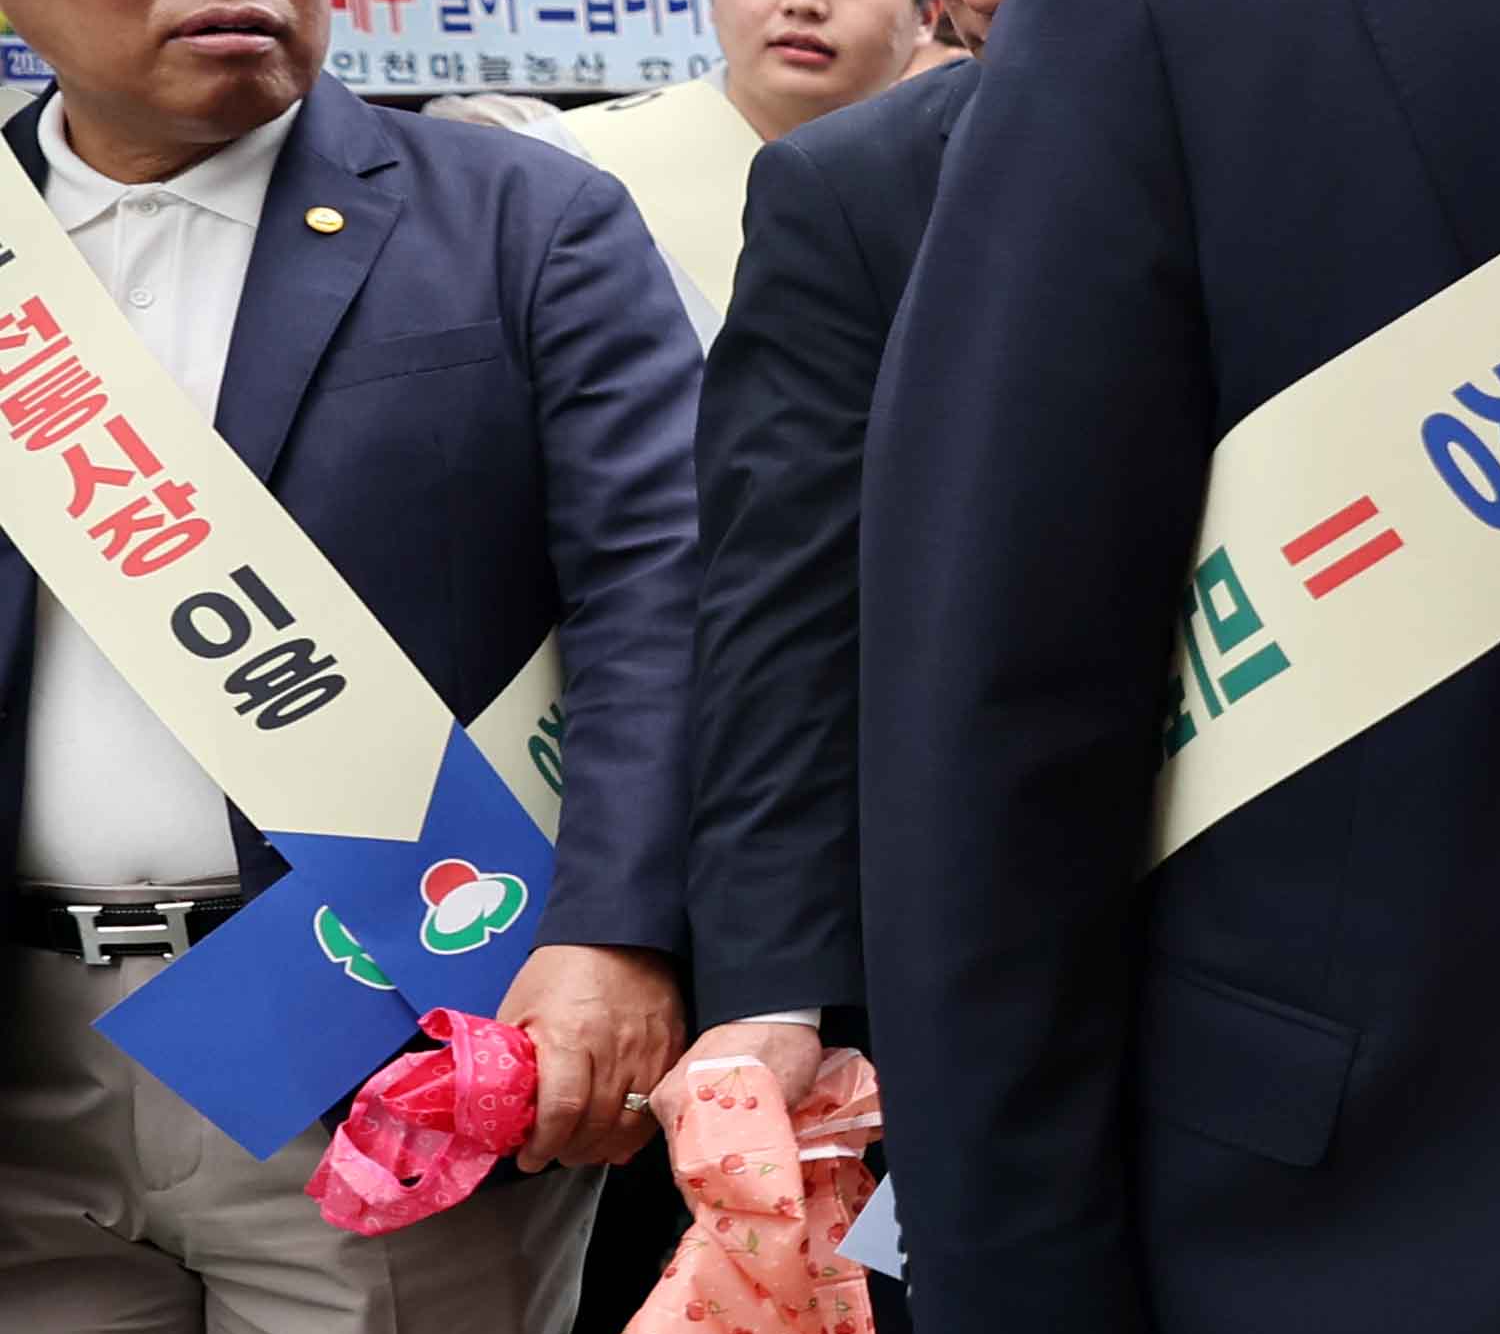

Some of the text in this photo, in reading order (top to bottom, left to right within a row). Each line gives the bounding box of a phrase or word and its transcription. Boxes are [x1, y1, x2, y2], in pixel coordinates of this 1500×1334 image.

[0, 295, 347, 731] 전통시장 이용
[1164, 544, 1292, 761] 민
